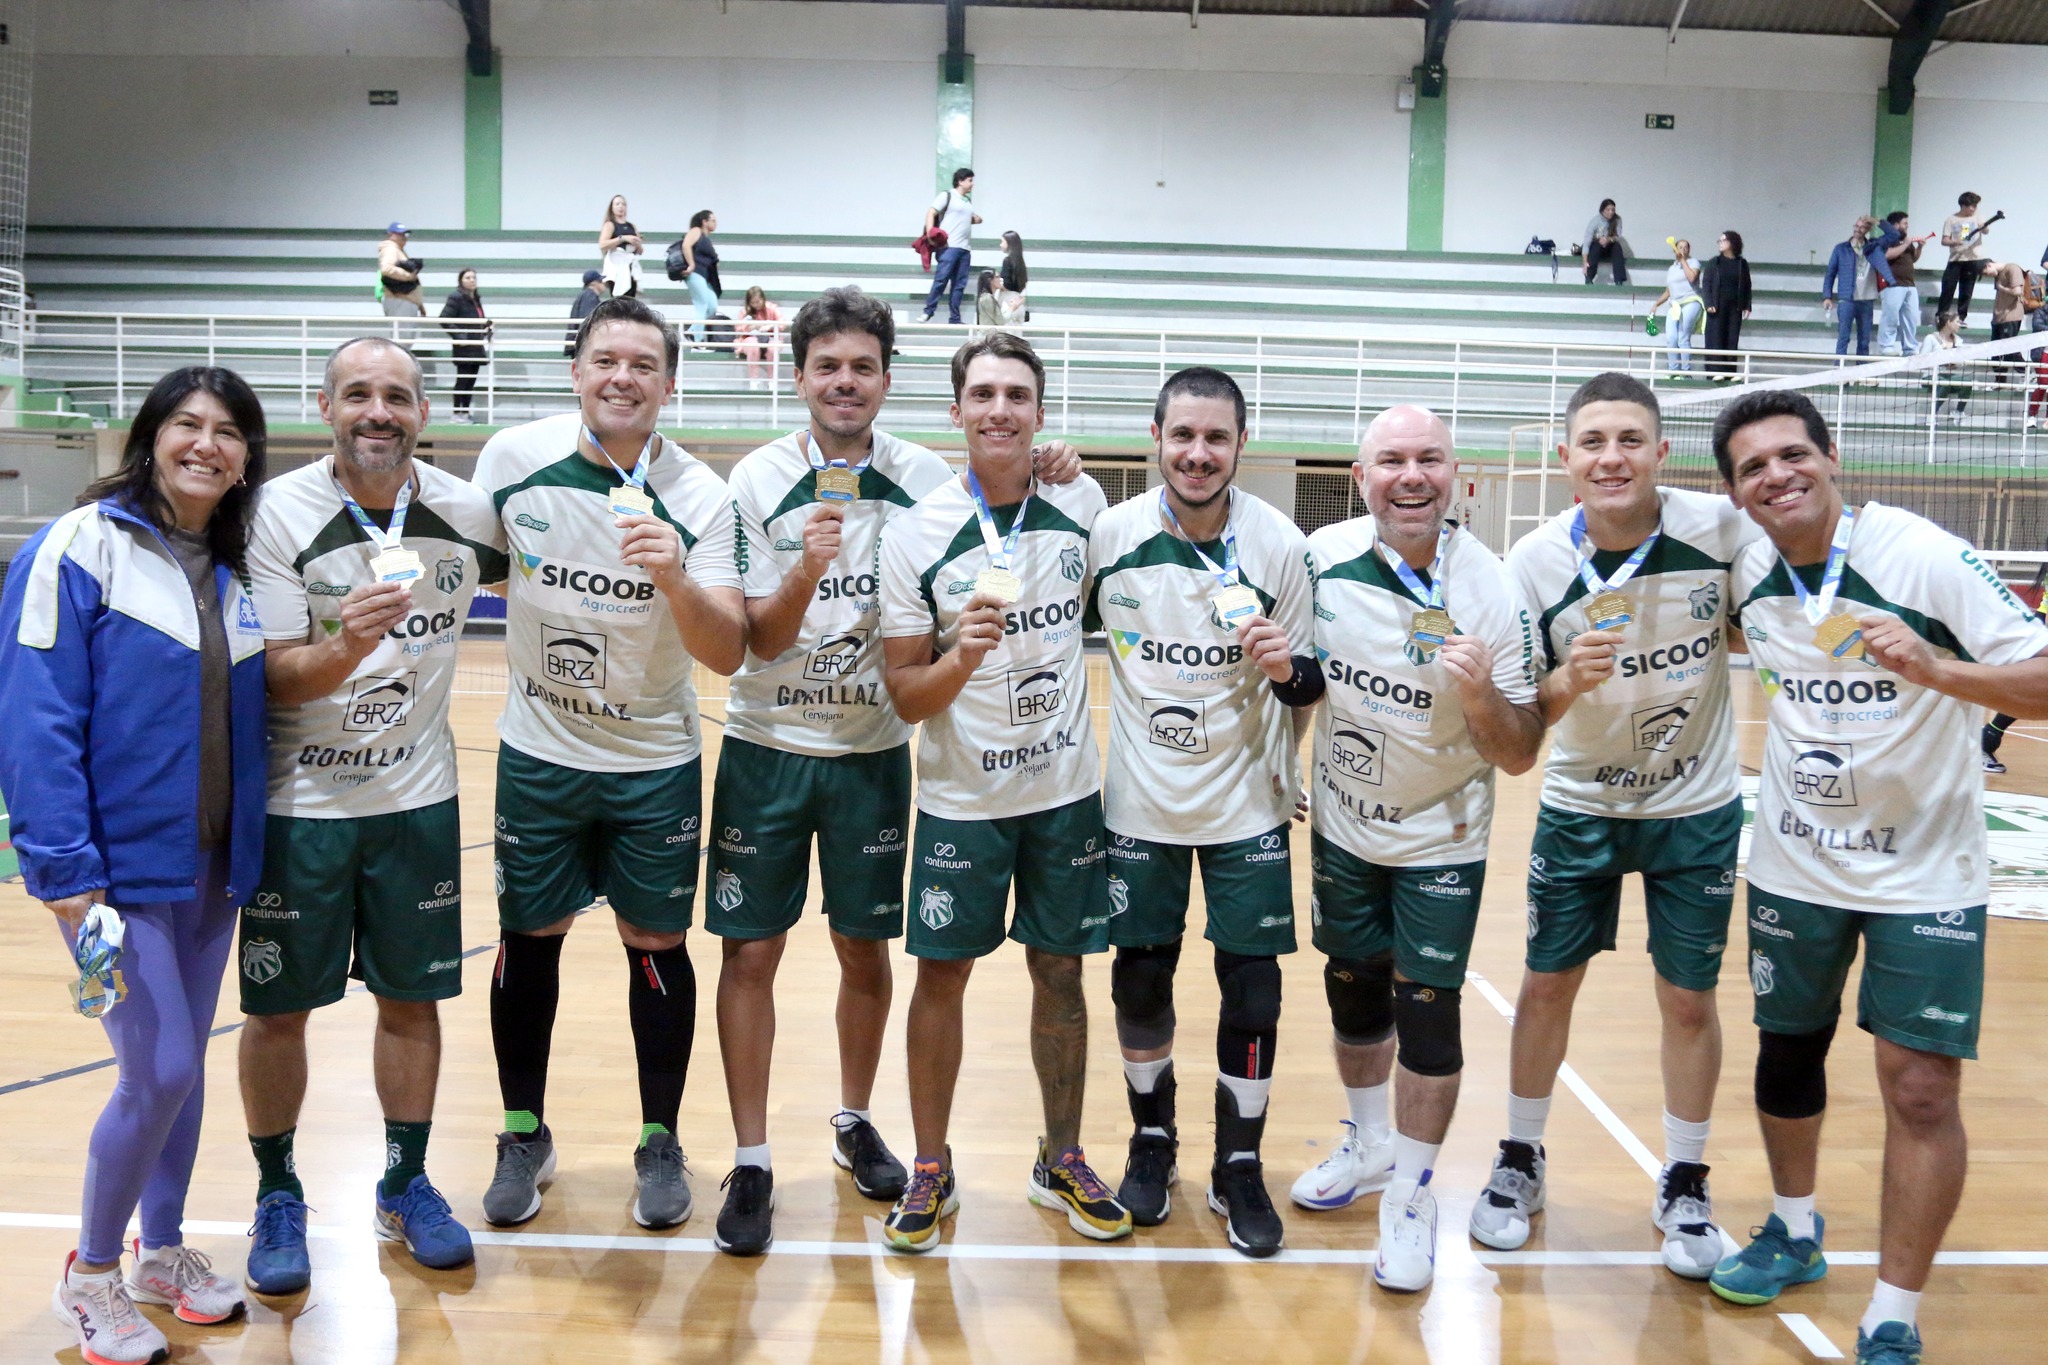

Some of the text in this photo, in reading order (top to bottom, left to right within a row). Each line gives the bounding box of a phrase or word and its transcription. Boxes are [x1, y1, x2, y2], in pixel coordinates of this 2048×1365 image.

[773, 539, 803, 551] Duso
[541, 564, 656, 602] SICOOB
[948, 580, 976, 595] Duso
[580, 596, 651, 615] Agrocredi
[1140, 639, 1244, 667] SICOOB
[1621, 626, 1720, 679] SICOOB
[547, 653, 595, 681] BRZ
[813, 654, 858, 675] BRZ
[1176, 665, 1241, 684] Agrocredi
[777, 682, 879, 707] GORILLAZ
[1328, 658, 1434, 710] SICOOB
[1782, 678, 1898, 705] SICOOB
[526, 676, 632, 721] GORILLAZ
[1017, 689, 1060, 718] BRZ
[1361, 695, 1430, 723] Agrocredi
[353, 702, 406, 725] BRZ
[1820, 705, 1899, 725] Agrocredi
[1641, 724, 1684, 746] BRZ
[1332, 741, 1373, 777] BRZ
[1793, 771, 1843, 799] BRZ
[717, 839, 757, 855] continuum
[1107, 846, 1150, 861] ontinuum
[924, 855, 972, 870] continuum
[1419, 882, 1471, 896] continuum
[245, 906, 300, 920] continuum
[1912, 924, 1978, 942] continuum
[72, 1303, 98, 1342] FILA
